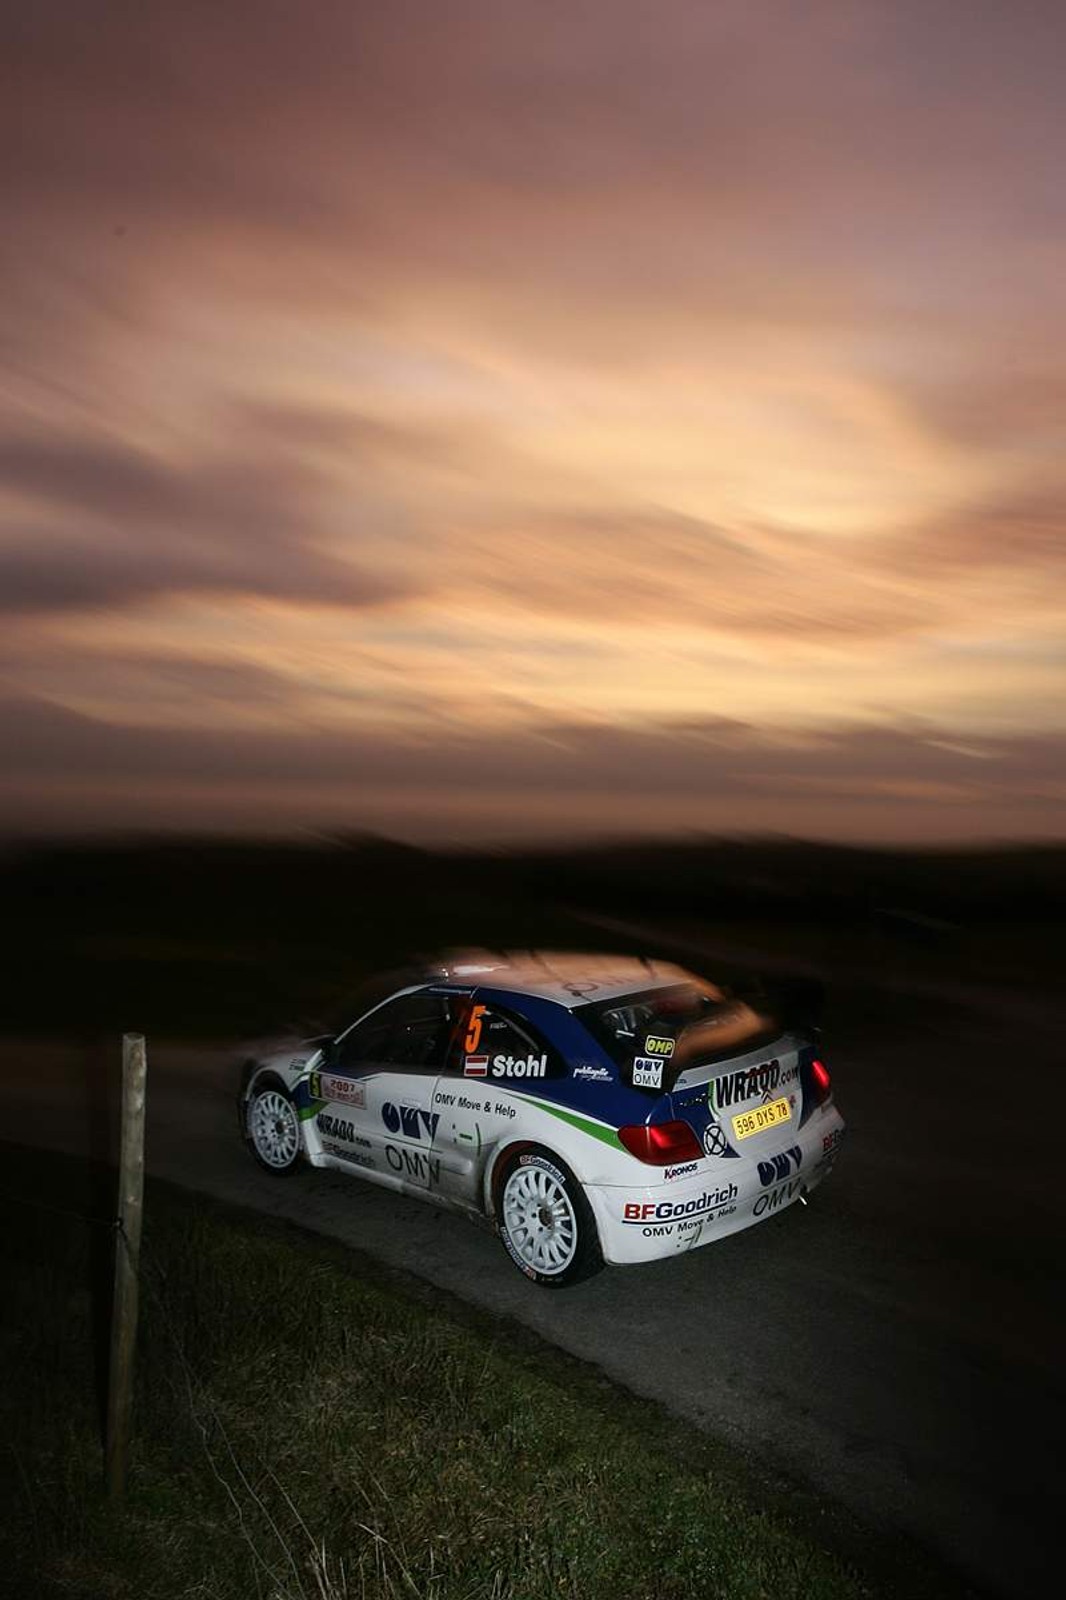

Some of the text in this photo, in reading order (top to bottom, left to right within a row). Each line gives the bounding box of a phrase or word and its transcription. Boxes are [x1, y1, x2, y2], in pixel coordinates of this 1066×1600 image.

[464, 1005, 487, 1054] 5
[647, 1038, 673, 1055] OMP
[491, 1054, 548, 1078] Stohl
[634, 1074, 660, 1087] OMV
[330, 1079, 355, 1092] 2007
[434, 1092, 517, 1120] OMV Move & Help
[736, 1102, 788, 1136] 596 DYS 78
[384, 1144, 440, 1184] OMV
[623, 1183, 738, 1220] BFGoodrich
[752, 1180, 800, 1217] OMV
[642, 1204, 737, 1238] OMV Move & Help
